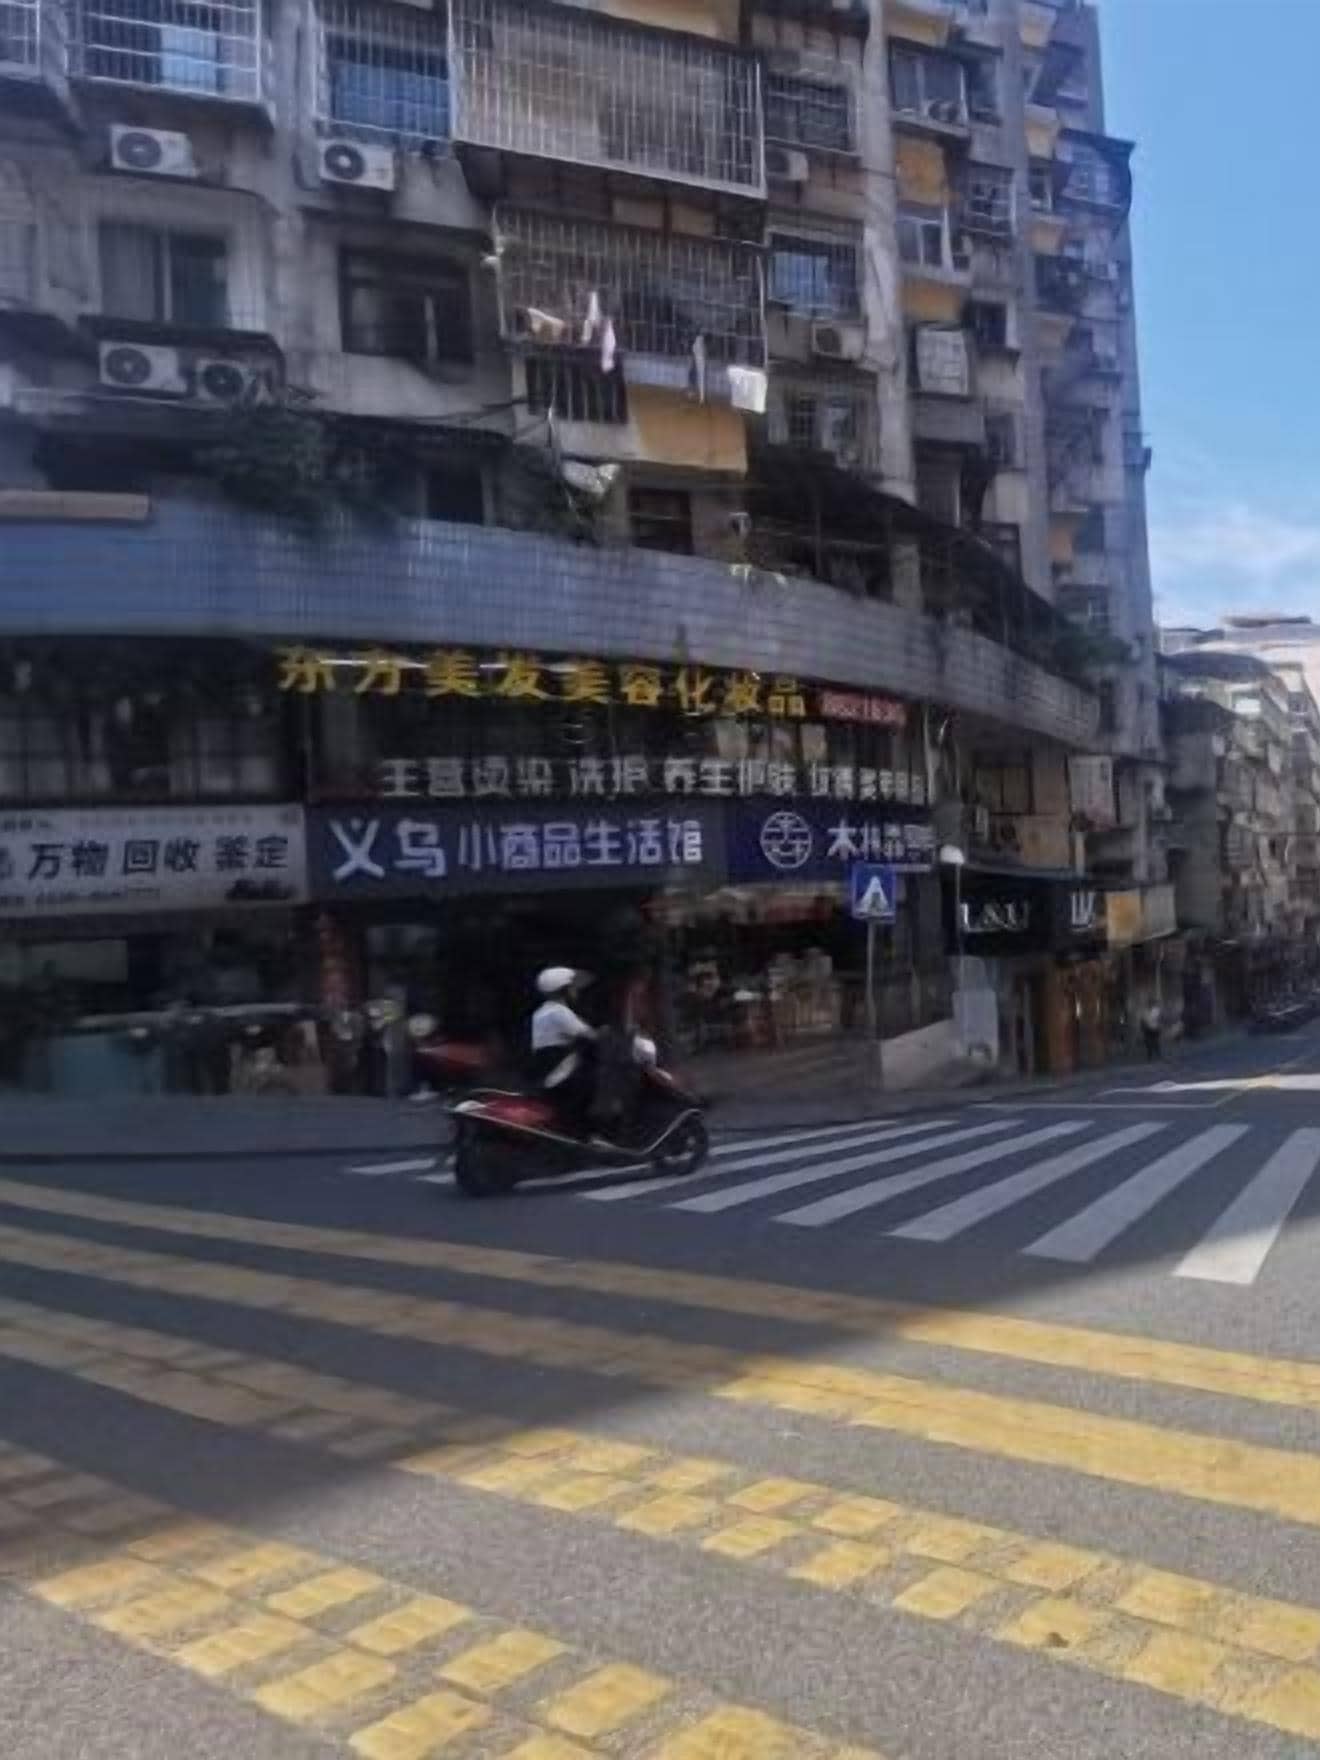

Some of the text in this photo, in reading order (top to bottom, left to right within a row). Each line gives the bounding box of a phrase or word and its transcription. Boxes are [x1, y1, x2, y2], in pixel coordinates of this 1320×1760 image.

[328, 816, 705, 882] 义乌小商品生活馆
